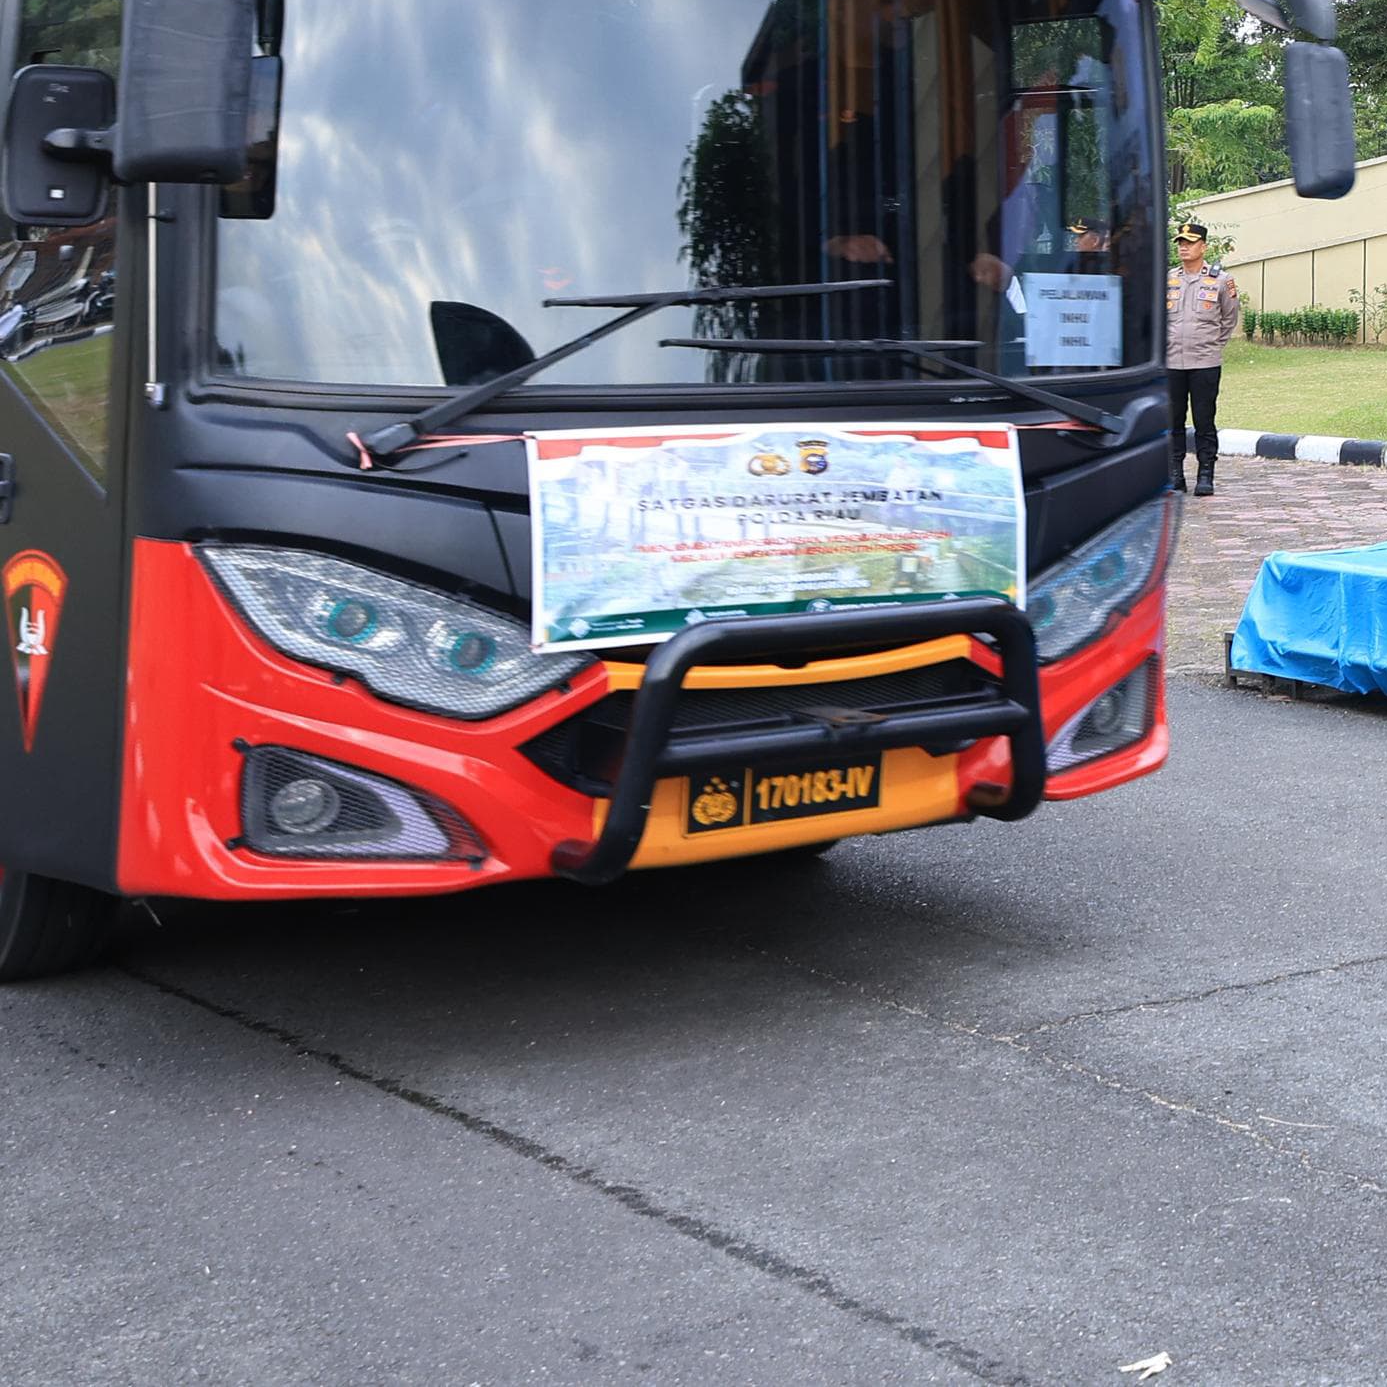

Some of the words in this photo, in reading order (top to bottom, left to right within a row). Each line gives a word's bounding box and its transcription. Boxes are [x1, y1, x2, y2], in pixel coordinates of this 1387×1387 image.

[637, 495, 727, 512] SATGAS
[732, 491, 833, 509] DARURAT
[839, 489, 943, 503] JEMBATAN
[738, 510, 806, 526] POLDA
[814, 508, 861, 522] RIAU
[755, 765, 875, 811] 170183-IV
